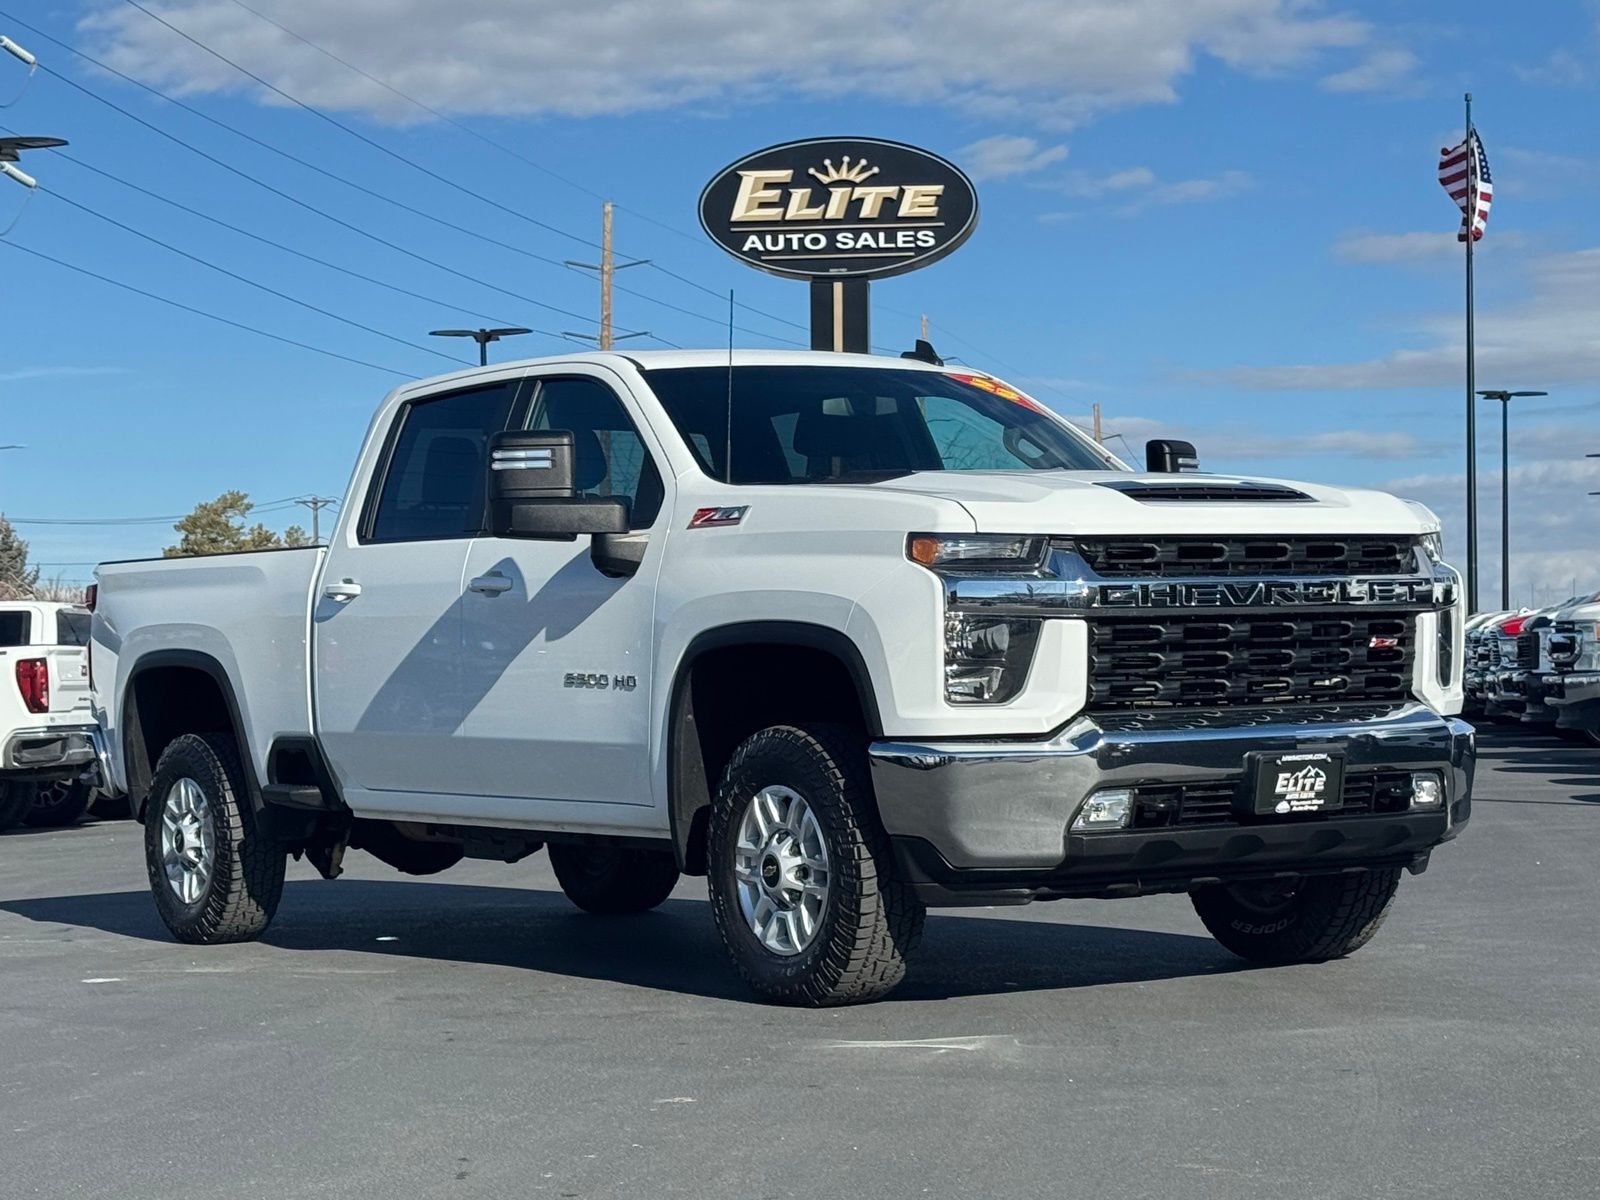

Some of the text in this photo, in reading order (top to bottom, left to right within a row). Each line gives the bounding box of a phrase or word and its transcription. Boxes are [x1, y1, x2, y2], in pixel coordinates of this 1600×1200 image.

[730, 169, 945, 222] ELITE
[742, 230, 936, 251] AUTO SALES
[1094, 579, 1424, 607] CHEVROLET
[1274, 773, 1326, 793] ELITE
